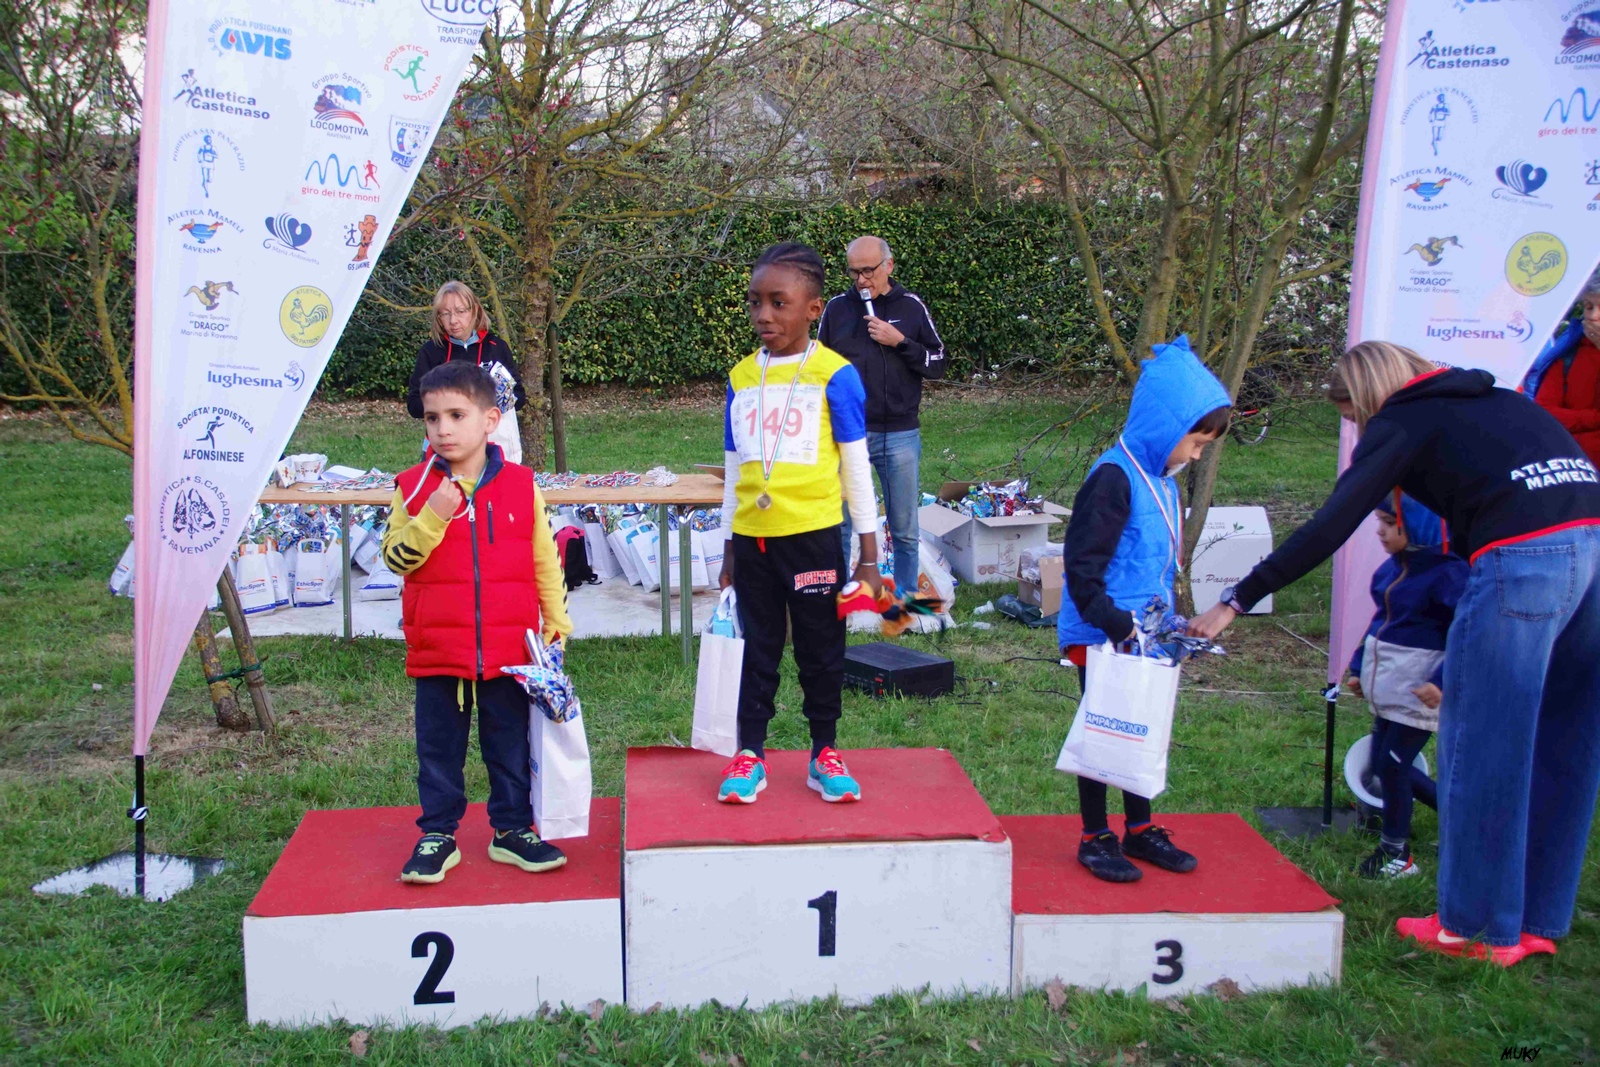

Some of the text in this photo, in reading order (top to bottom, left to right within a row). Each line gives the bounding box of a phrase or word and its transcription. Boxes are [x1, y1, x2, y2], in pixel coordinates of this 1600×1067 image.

[209, 17, 248, 34] PODISTICA
[249, 21, 293, 36] FUSIGNANO
[220, 27, 292, 61] AVIS
[1430, 45, 1496, 57] Atletica
[384, 44, 429, 71] PODISTICA
[1426, 58, 1510, 70] Castenaso
[312, 72, 372, 98] Gruppo Sportivo
[403, 75, 442, 102] VOLTANA
[194, 86, 256, 106] Atletica
[190, 98, 270, 120] Castenaso
[310, 120, 369, 136] LOCOMOTIVA
[1538, 126, 1597, 138] giro dei tre
[1390, 166, 1472, 186] ATLETICA MAMELI
[302, 186, 319, 195] giro
[322, 188, 336, 196] dei
[354, 194, 380, 202] monti
[1406, 202, 1449, 212] RAVENNA
[166, 208, 244, 234] ATLETICA MAMELI
[182, 243, 222, 254] RAVENNA
[1410, 277, 1452, 286] "DRAGO"
[190, 320, 230, 332] "DRAGO"
[1426, 325, 1504, 342] lughesina
[208, 371, 283, 388] lughesina
[177, 406, 255, 434] SOCIETA' PODISTICA
[745, 407, 803, 437] 149
[183, 450, 245, 463] ALFONSINESE
[1510, 458, 1596, 480] ATLETICA
[1525, 470, 1598, 490] MAMELI
[160, 477, 187, 533] PODISTICA
[168, 536, 221, 555] RAVENNA
[1206, 574, 1240, 586] Pasqua
[807, 890, 837, 956] 1
[412, 931, 456, 1005] 2
[1152, 940, 1184, 984] 3
